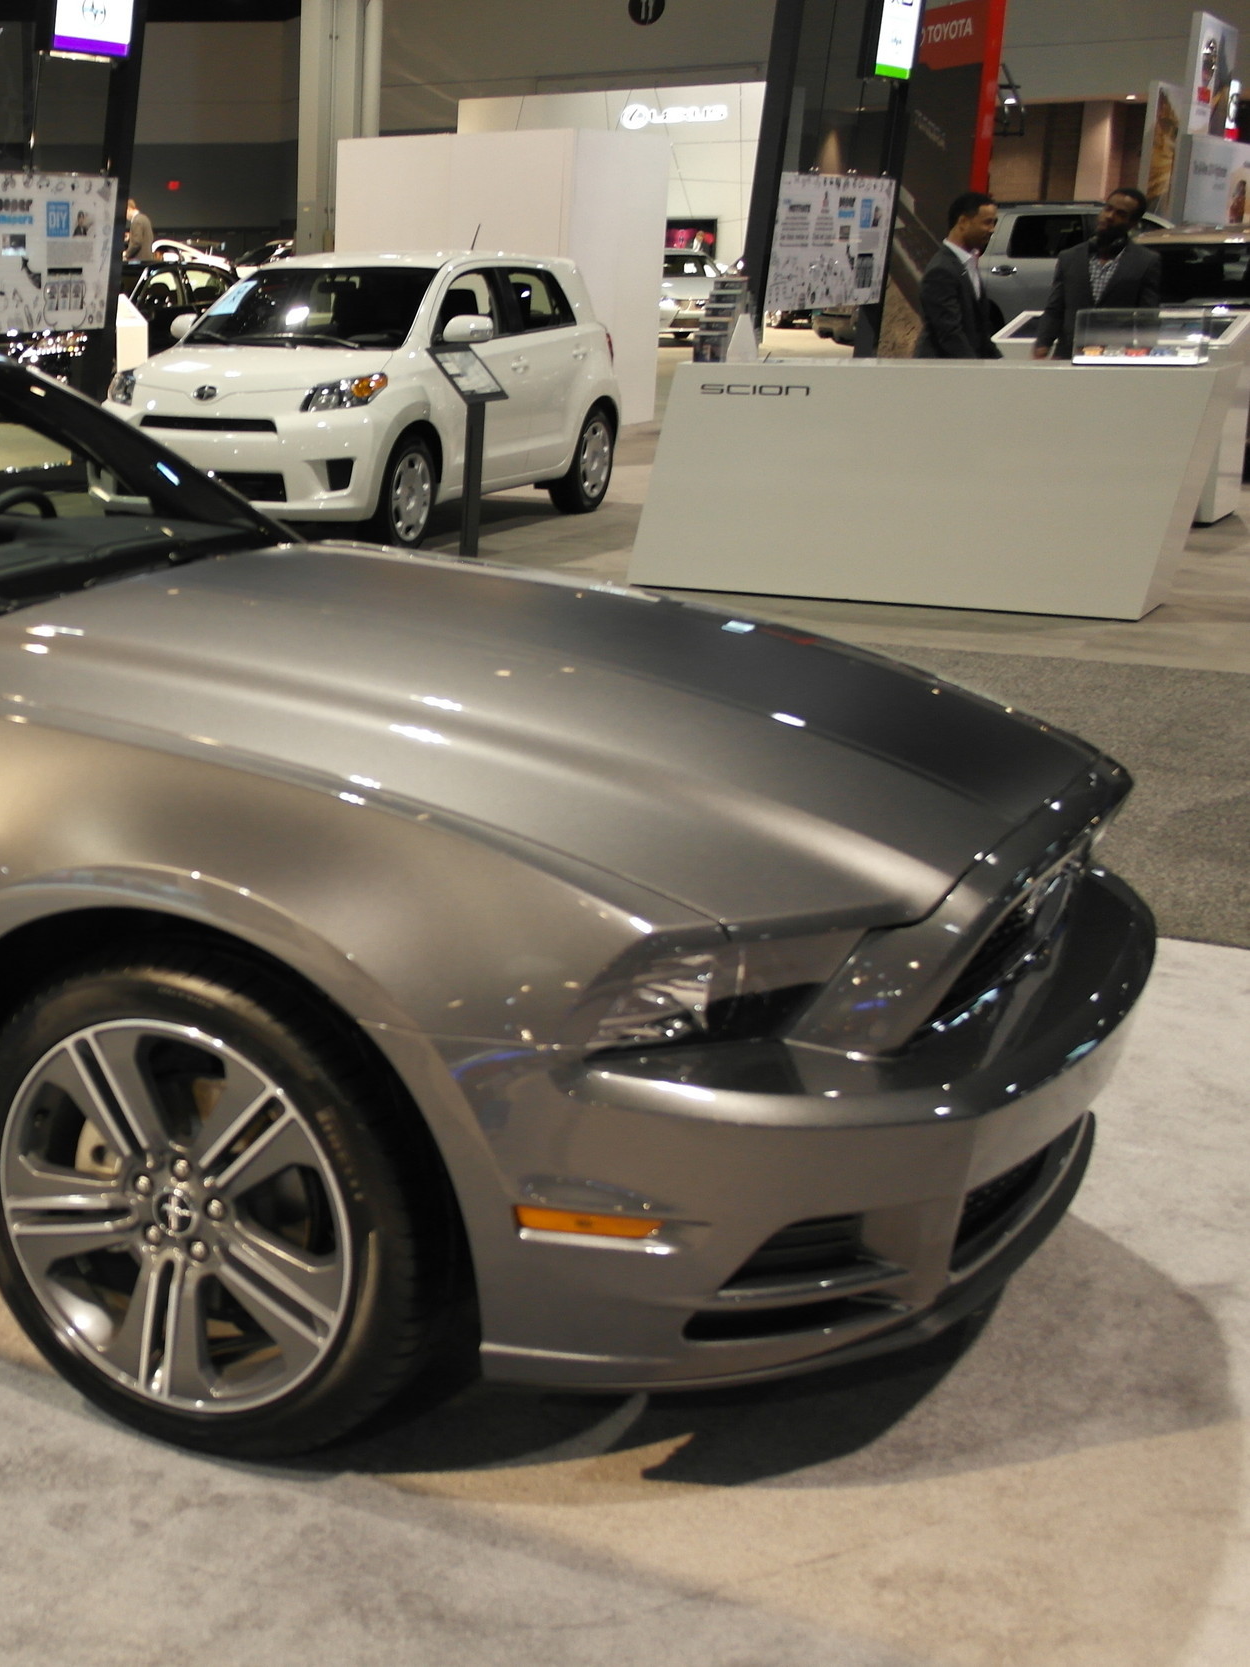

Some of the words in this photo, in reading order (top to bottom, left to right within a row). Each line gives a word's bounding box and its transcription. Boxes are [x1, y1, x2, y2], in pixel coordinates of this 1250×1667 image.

[927, 17, 973, 43] TOYOTA
[49, 210, 68, 229] DIY
[701, 384, 810, 396] SCION
